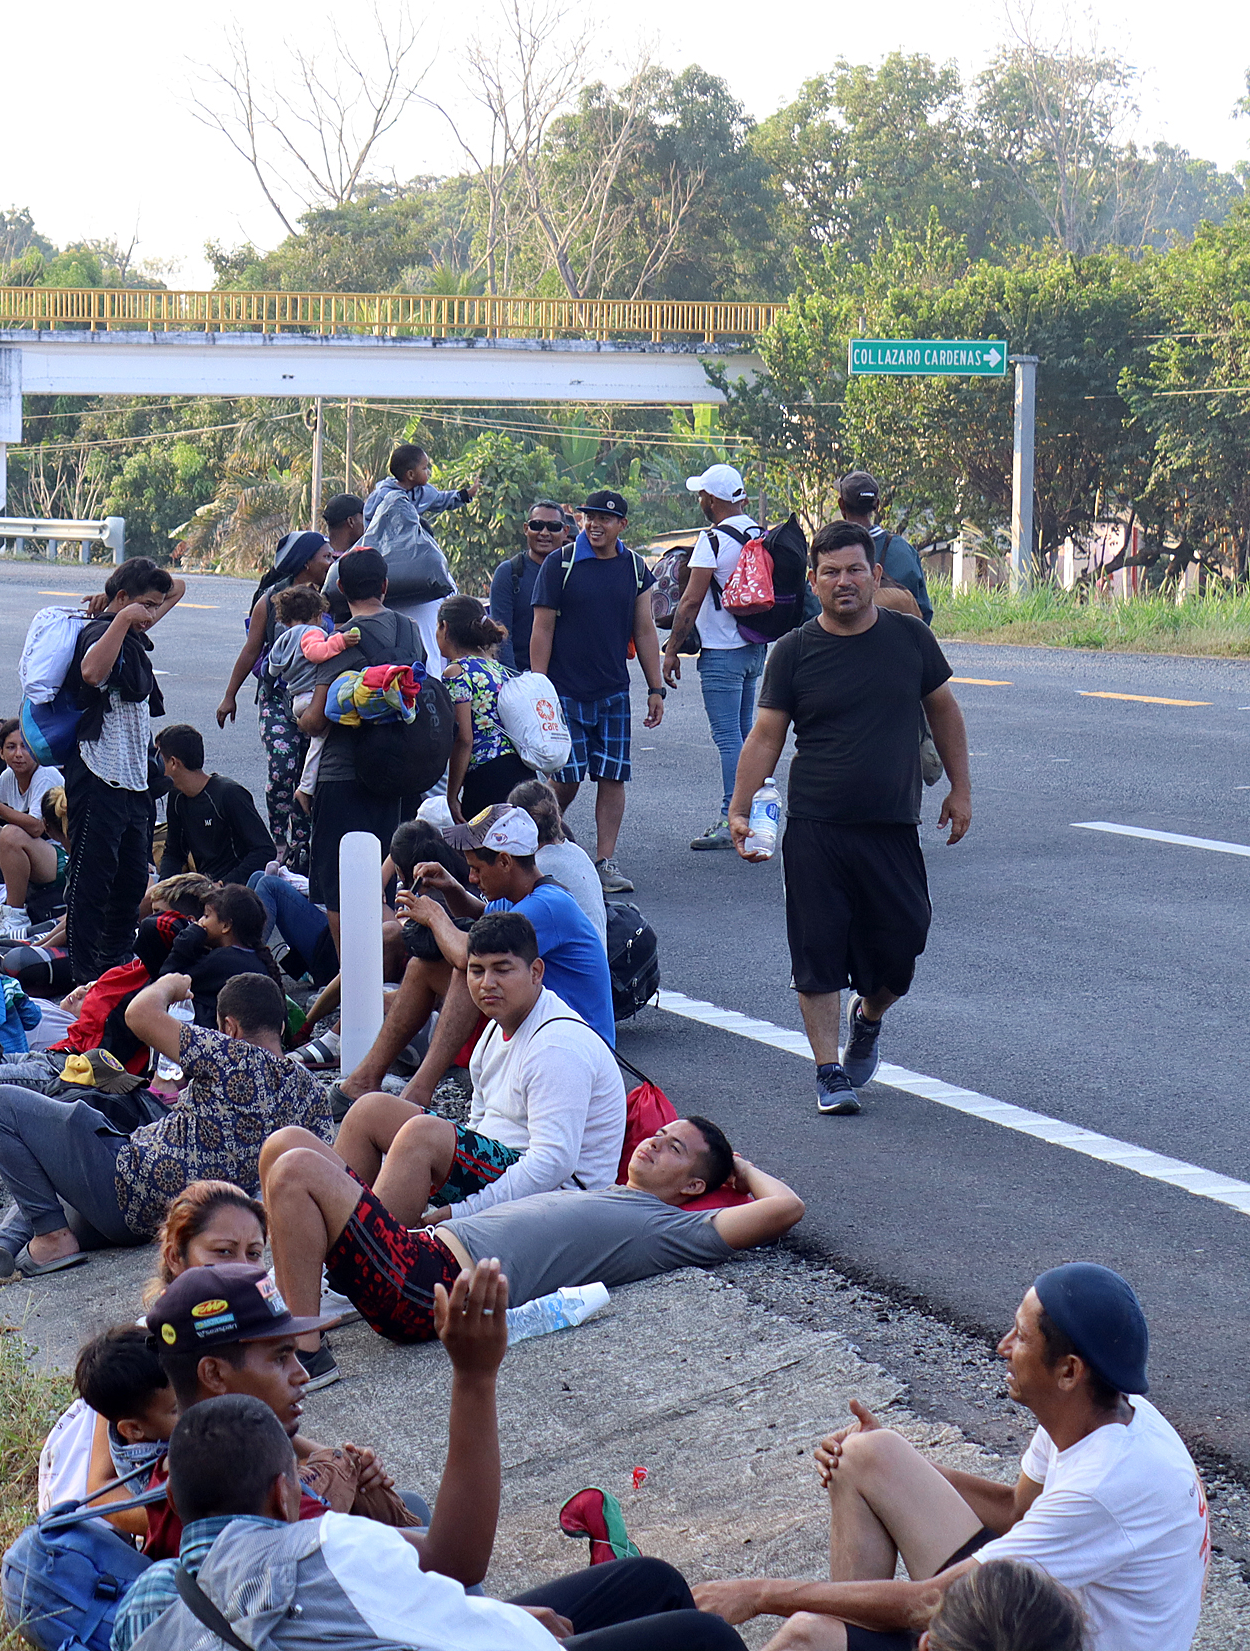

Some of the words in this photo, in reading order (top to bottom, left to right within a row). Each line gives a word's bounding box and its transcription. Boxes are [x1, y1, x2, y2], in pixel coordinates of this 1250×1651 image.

[924, 349, 982, 366] CARDENAS
[422, 688, 443, 766] Reebo
[542, 722, 559, 732] care
